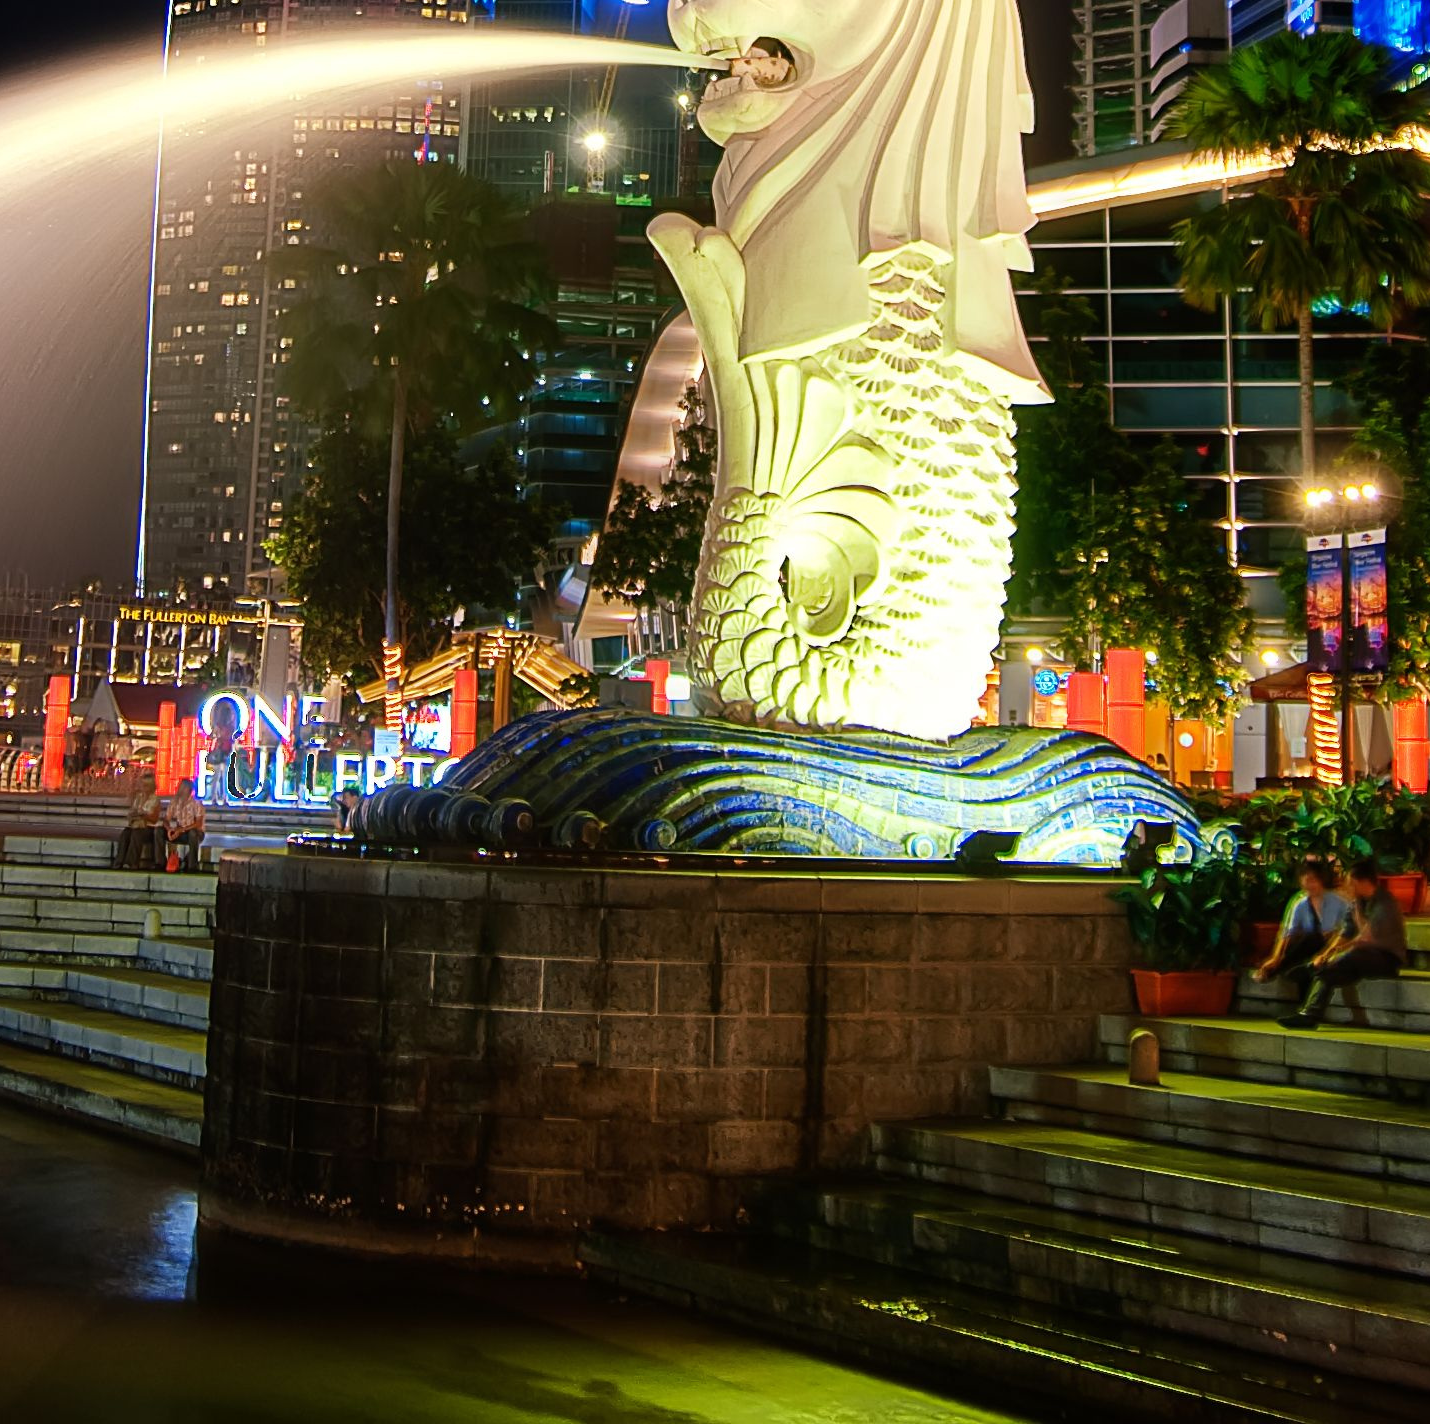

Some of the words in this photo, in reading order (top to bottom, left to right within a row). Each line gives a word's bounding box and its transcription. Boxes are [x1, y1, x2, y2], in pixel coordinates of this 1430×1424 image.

[119, 607, 141, 621] THE
[143, 609, 208, 625] FULLERTON
[209, 610, 231, 626] BAY
[198, 689, 328, 746] ONE
